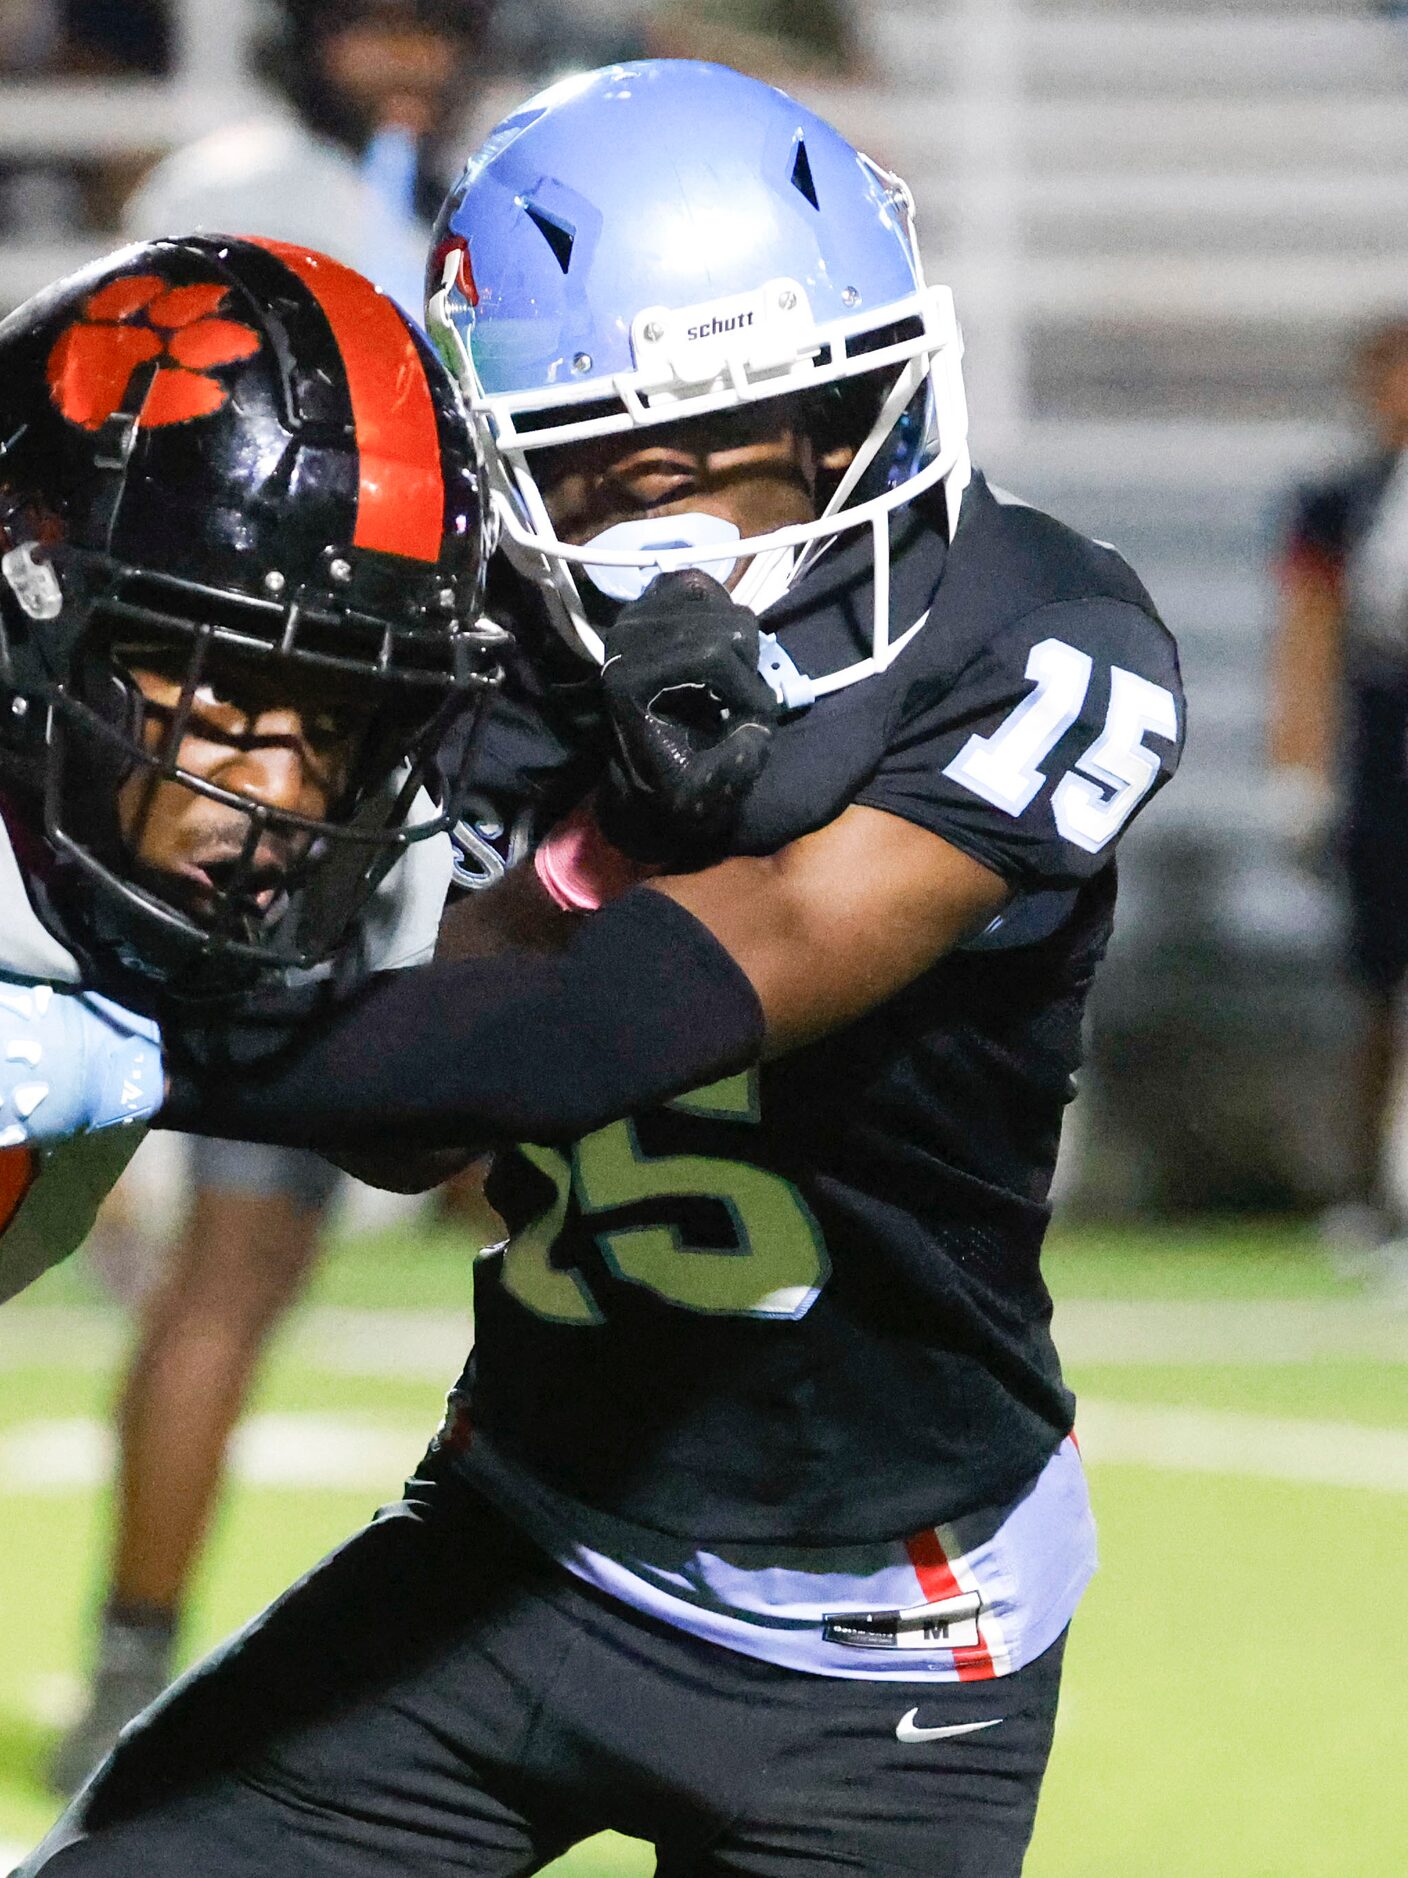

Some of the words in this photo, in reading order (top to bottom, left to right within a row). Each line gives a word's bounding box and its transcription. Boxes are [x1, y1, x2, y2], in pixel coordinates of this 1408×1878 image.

[687, 311, 754, 341] schutt
[941, 637, 1178, 854] 15
[923, 1618, 950, 1640] M
